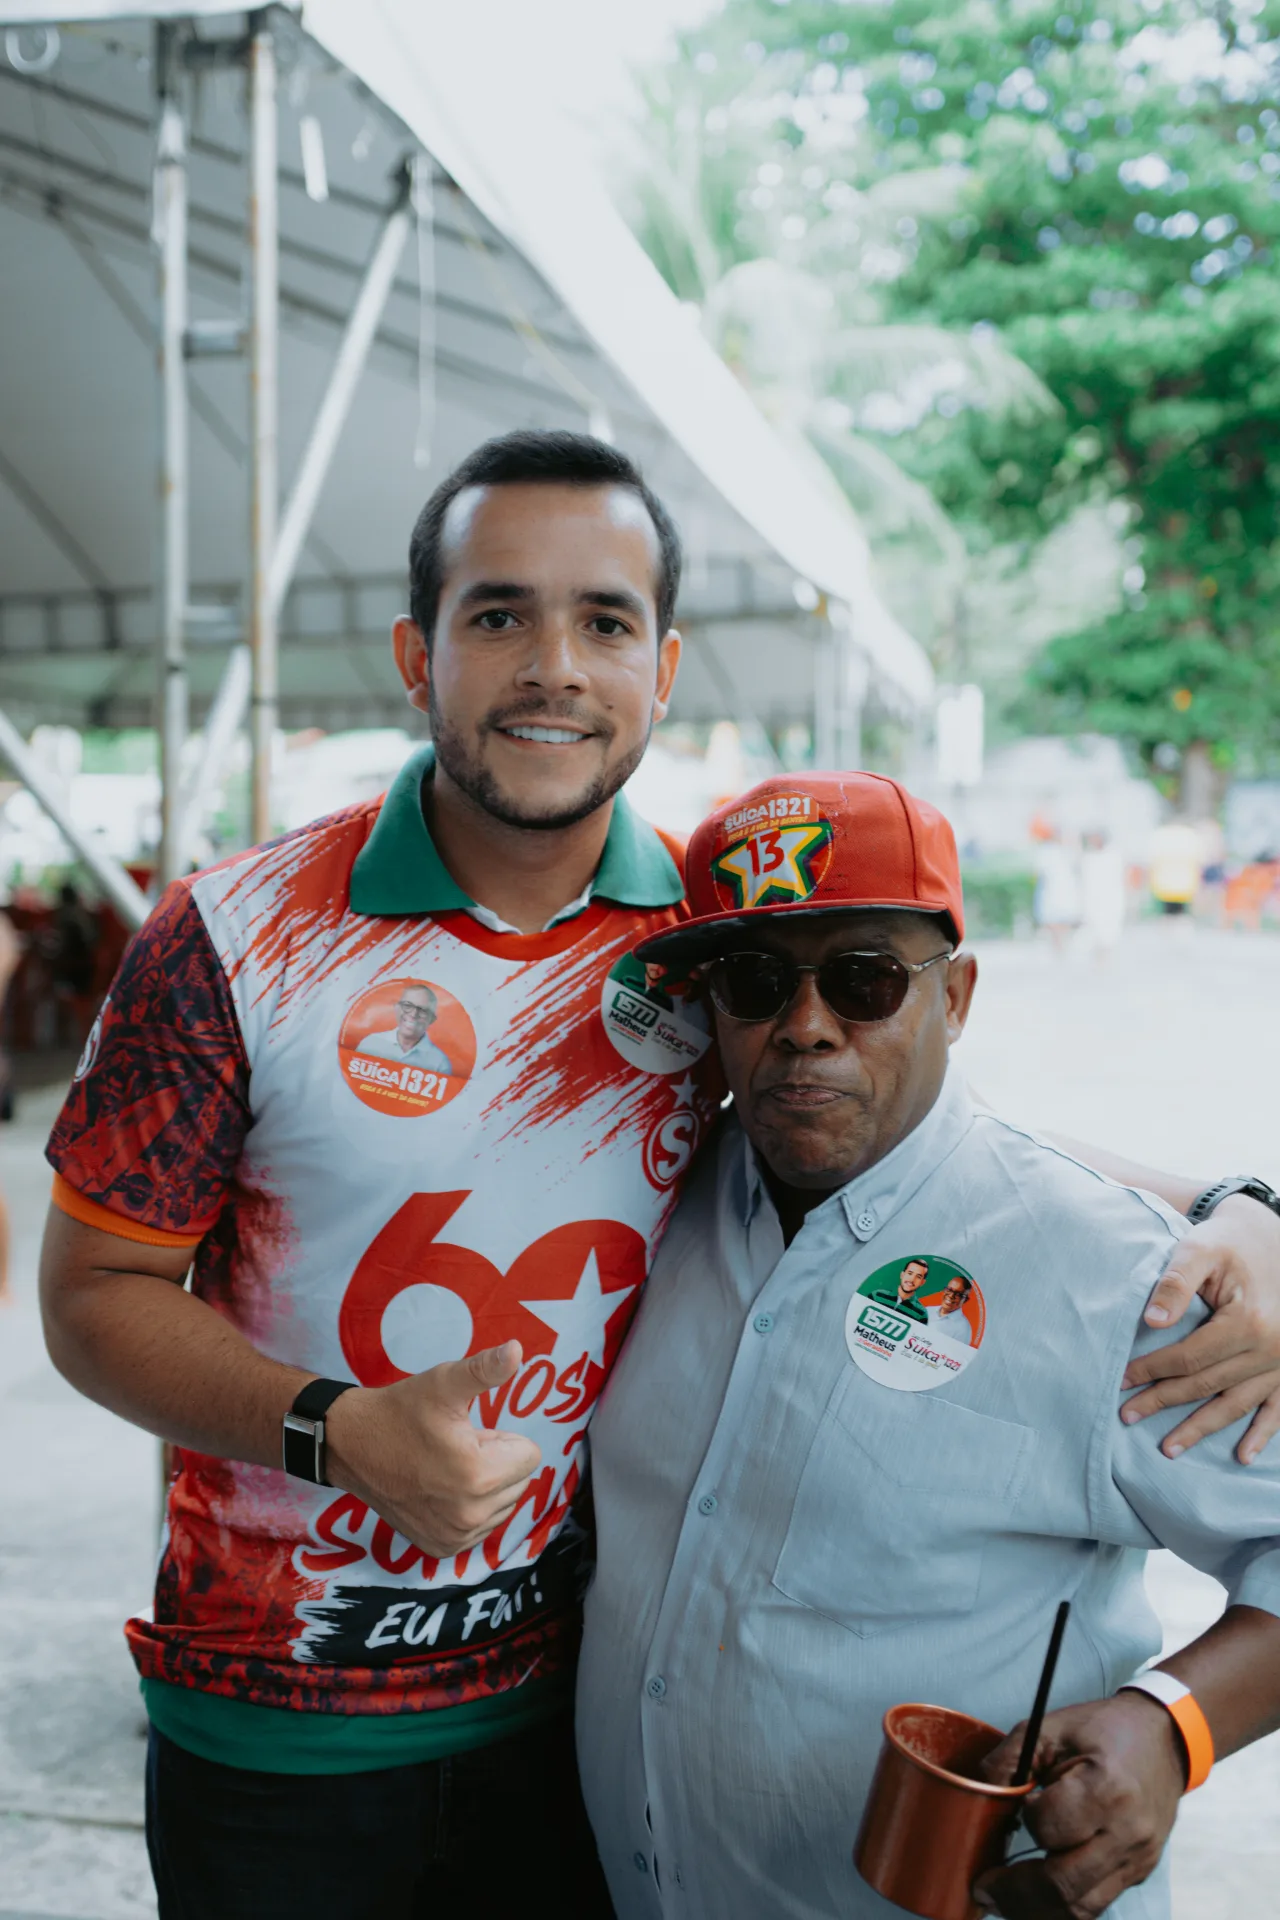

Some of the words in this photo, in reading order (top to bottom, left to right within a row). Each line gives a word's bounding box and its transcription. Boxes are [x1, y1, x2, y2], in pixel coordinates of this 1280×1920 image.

[767, 797, 811, 819] 1321
[746, 830, 785, 877] 13
[608, 1010, 648, 1038] Matheus
[399, 1067, 449, 1101] 1321
[853, 1325, 897, 1352] Matheus
[364, 1602, 450, 1650] EU
